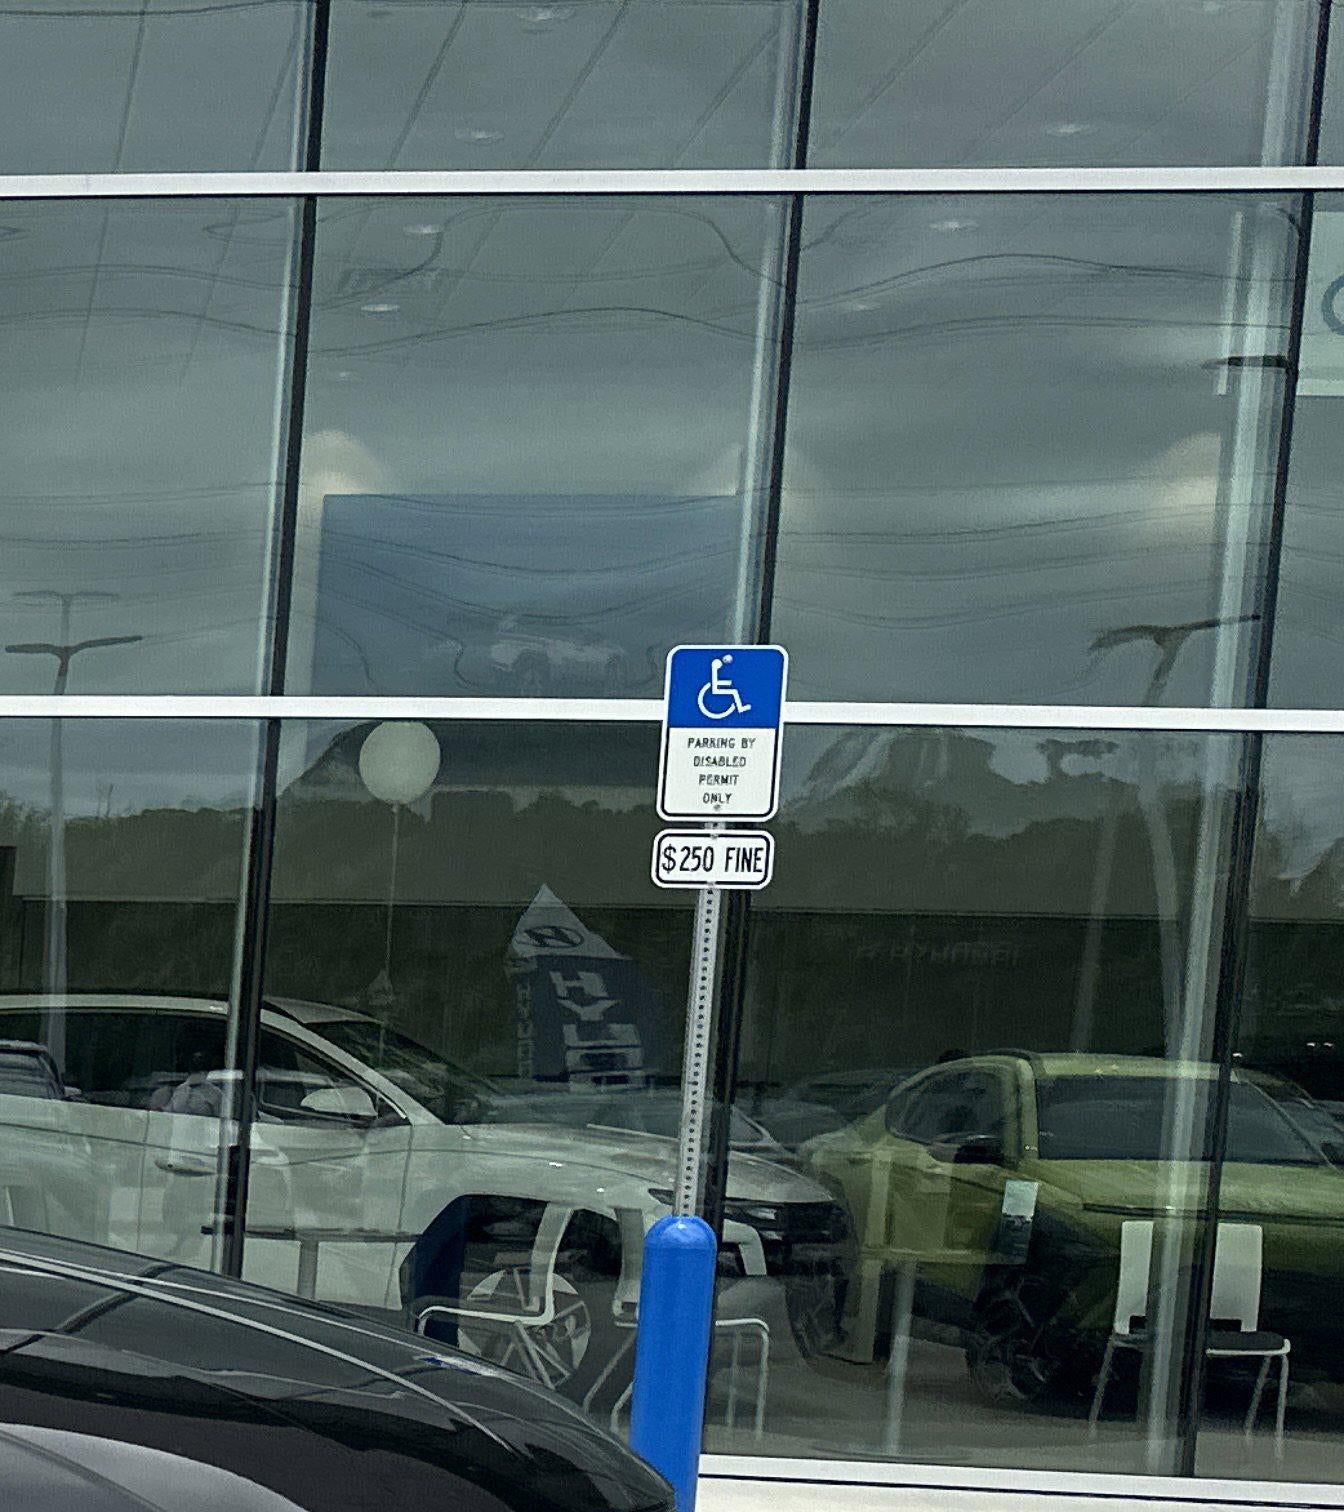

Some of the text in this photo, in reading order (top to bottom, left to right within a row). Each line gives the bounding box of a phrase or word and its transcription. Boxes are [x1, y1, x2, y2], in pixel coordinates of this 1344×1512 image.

[687, 737, 756, 749] PARKING BY
[693, 755, 747, 767] DISABLED
[698, 774, 740, 786] PERMIT
[702, 792, 732, 804] ONLY
[662, 844, 765, 874] $250 FINE
